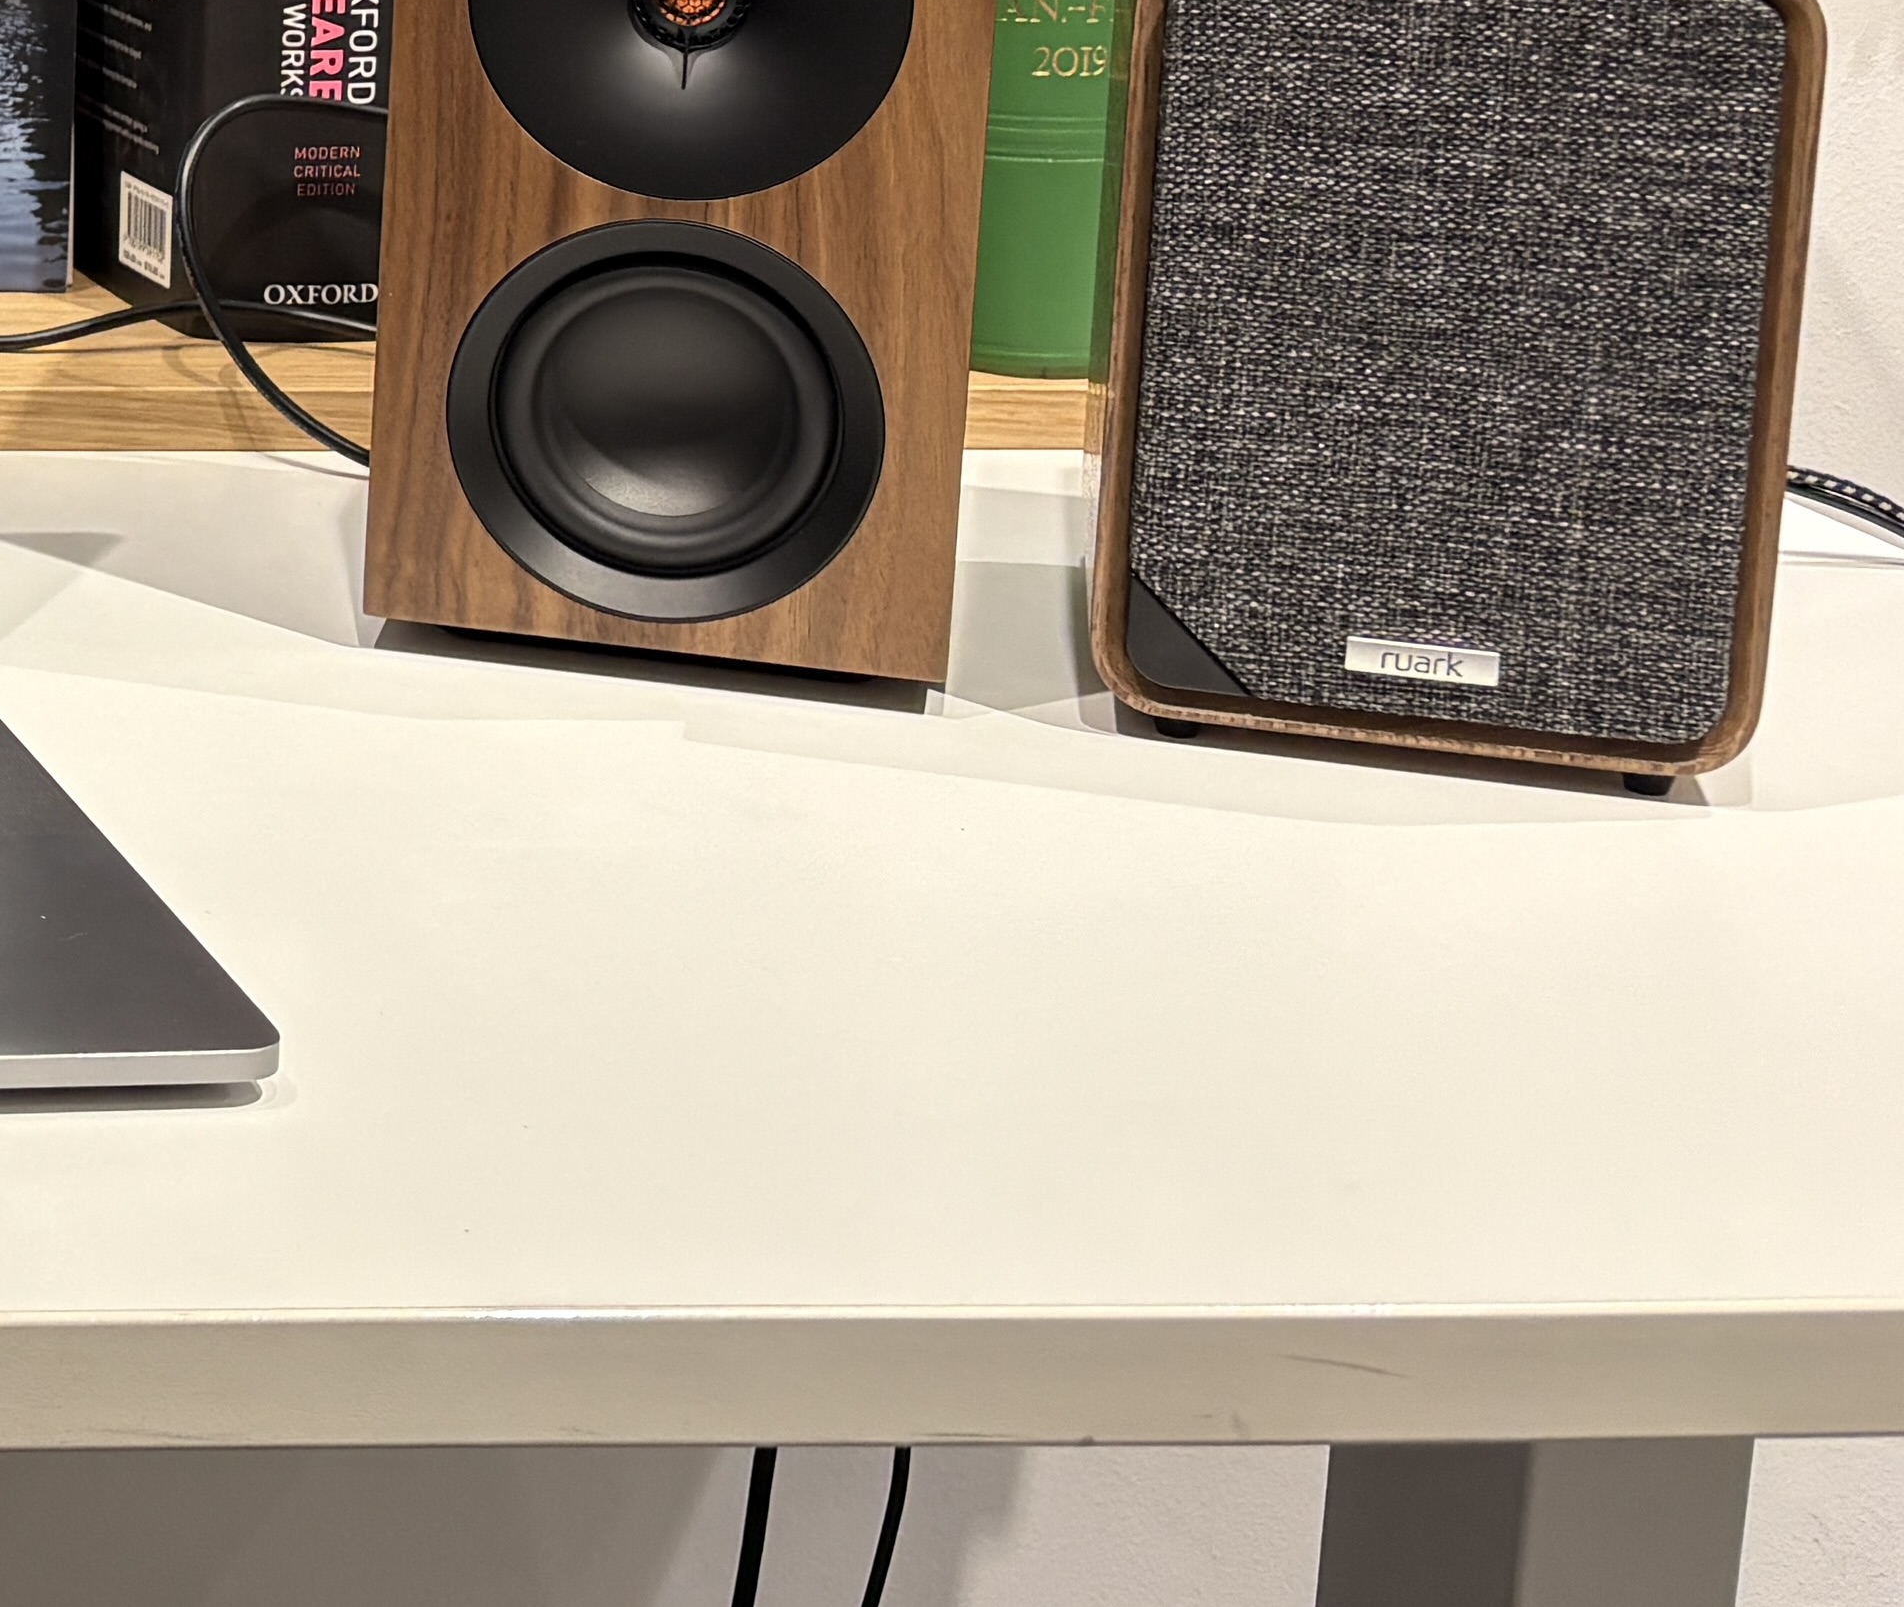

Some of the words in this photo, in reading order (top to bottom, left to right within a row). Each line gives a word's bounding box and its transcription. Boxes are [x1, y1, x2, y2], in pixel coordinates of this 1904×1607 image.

[1031, 45, 1107, 77] 2019
[294, 145, 361, 161] MODERN
[293, 164, 361, 178] CRITICAL
[296, 182, 356, 197] EDITION
[263, 282, 378, 306] OXFORD
[1380, 651, 1464, 678] ruark
